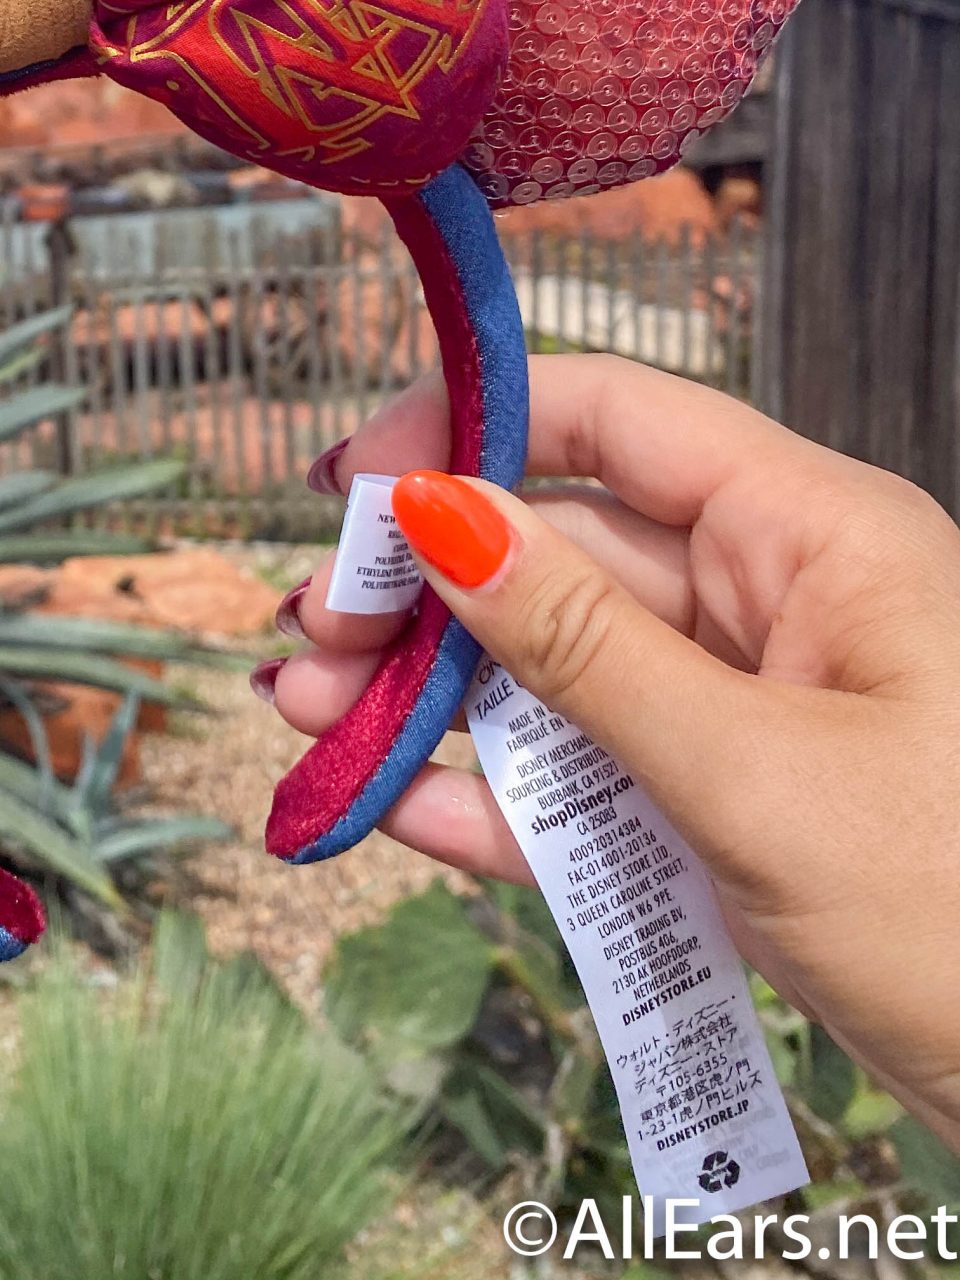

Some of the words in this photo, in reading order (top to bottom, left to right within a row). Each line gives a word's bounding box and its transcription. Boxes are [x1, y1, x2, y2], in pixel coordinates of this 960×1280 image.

[475, 678, 514, 720] TAILLE
[508, 711, 534, 734] MADE
[533, 705, 546, 720] IN
[506, 721, 550, 753] FABRIQUÉ
[549, 716, 564, 732] EN
[506, 773, 553, 803] SOURCING
[551, 769, 562, 782] &
[516, 752, 550, 779] DISNEY
[537, 780, 584, 810] BURBANK,
[581, 774, 595, 789] CA
[592, 760, 619, 783] 91521
[569, 816, 642, 864] 400920314384
[576, 822, 590, 836] CA
[590, 806, 618, 831] 25083
[566, 889, 586, 909] THE
[589, 871, 623, 901] DISNEY
[623, 856, 654, 885] STORE
[567, 830, 657, 886] FAC-014001-20136
[567, 917, 576, 932] 3
[578, 901, 609, 927] QUEEN
[609, 877, 654, 911] CAROLINE
[653, 857, 689, 887] STREET,
[597, 907, 636, 939] LONDON
[635, 898, 653, 918] W6
[603, 934, 634, 961] DISNEY
[633, 913, 671, 943] TRADING
[671, 906, 687, 924] BV,
[618, 942, 658, 972] POSTBUS
[657, 931, 679, 950] 406,
[612, 972, 637, 995] 2130
[637, 966, 650, 982] AK
[648, 935, 702, 975] HOOFDDORP,
[633, 958, 692, 1001] NETHERLANDS
[622, 966, 712, 1026] DISNEYSTORE.EU
[634, 1012, 732, 1077] ジャパン株式会社
[634, 1027, 738, 1095] ディズニー・ストア
[640, 1058, 751, 1125] 東京都港区虎ノ門
[656, 1099, 750, 1151] DISNEYSTORE.JP
